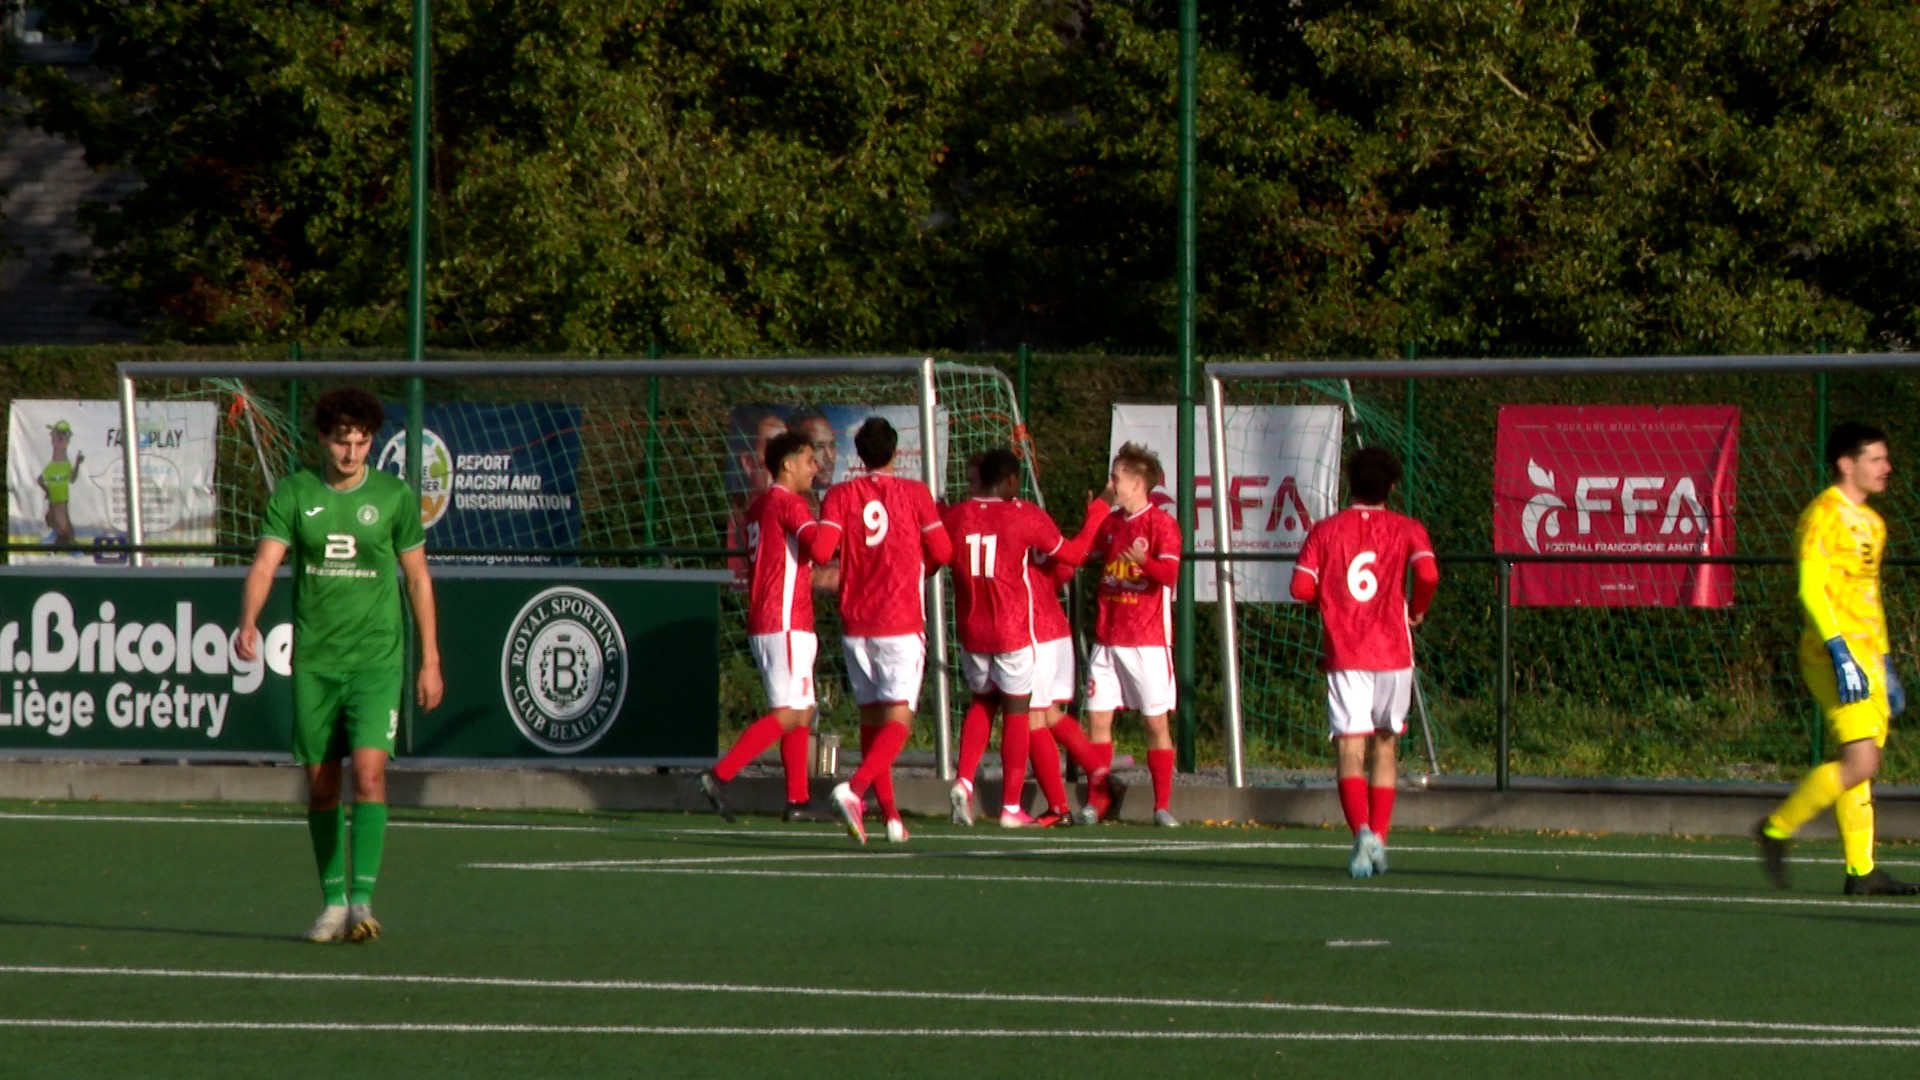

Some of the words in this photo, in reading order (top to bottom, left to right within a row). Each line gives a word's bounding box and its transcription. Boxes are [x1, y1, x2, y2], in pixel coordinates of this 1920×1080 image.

[455, 474, 509, 490] RACISM
[510, 475, 541, 490] AND
[457, 455, 511, 470] REPORT
[455, 494, 571, 510] DISCRIMINATION
[863, 500, 889, 547] 9
[1575, 477, 1710, 534] FFA
[965, 533, 997, 579] 11
[1545, 543, 1593, 552] FOOTBALL
[1595, 543, 1666, 552] FRANCOPHONE
[1347, 551, 1378, 602] 6
[512, 606, 550, 666] ROYAL
[551, 598, 619, 662] SPORTING
[105, 679, 229, 738] Grétry
[514, 685, 547, 731] CLUB
